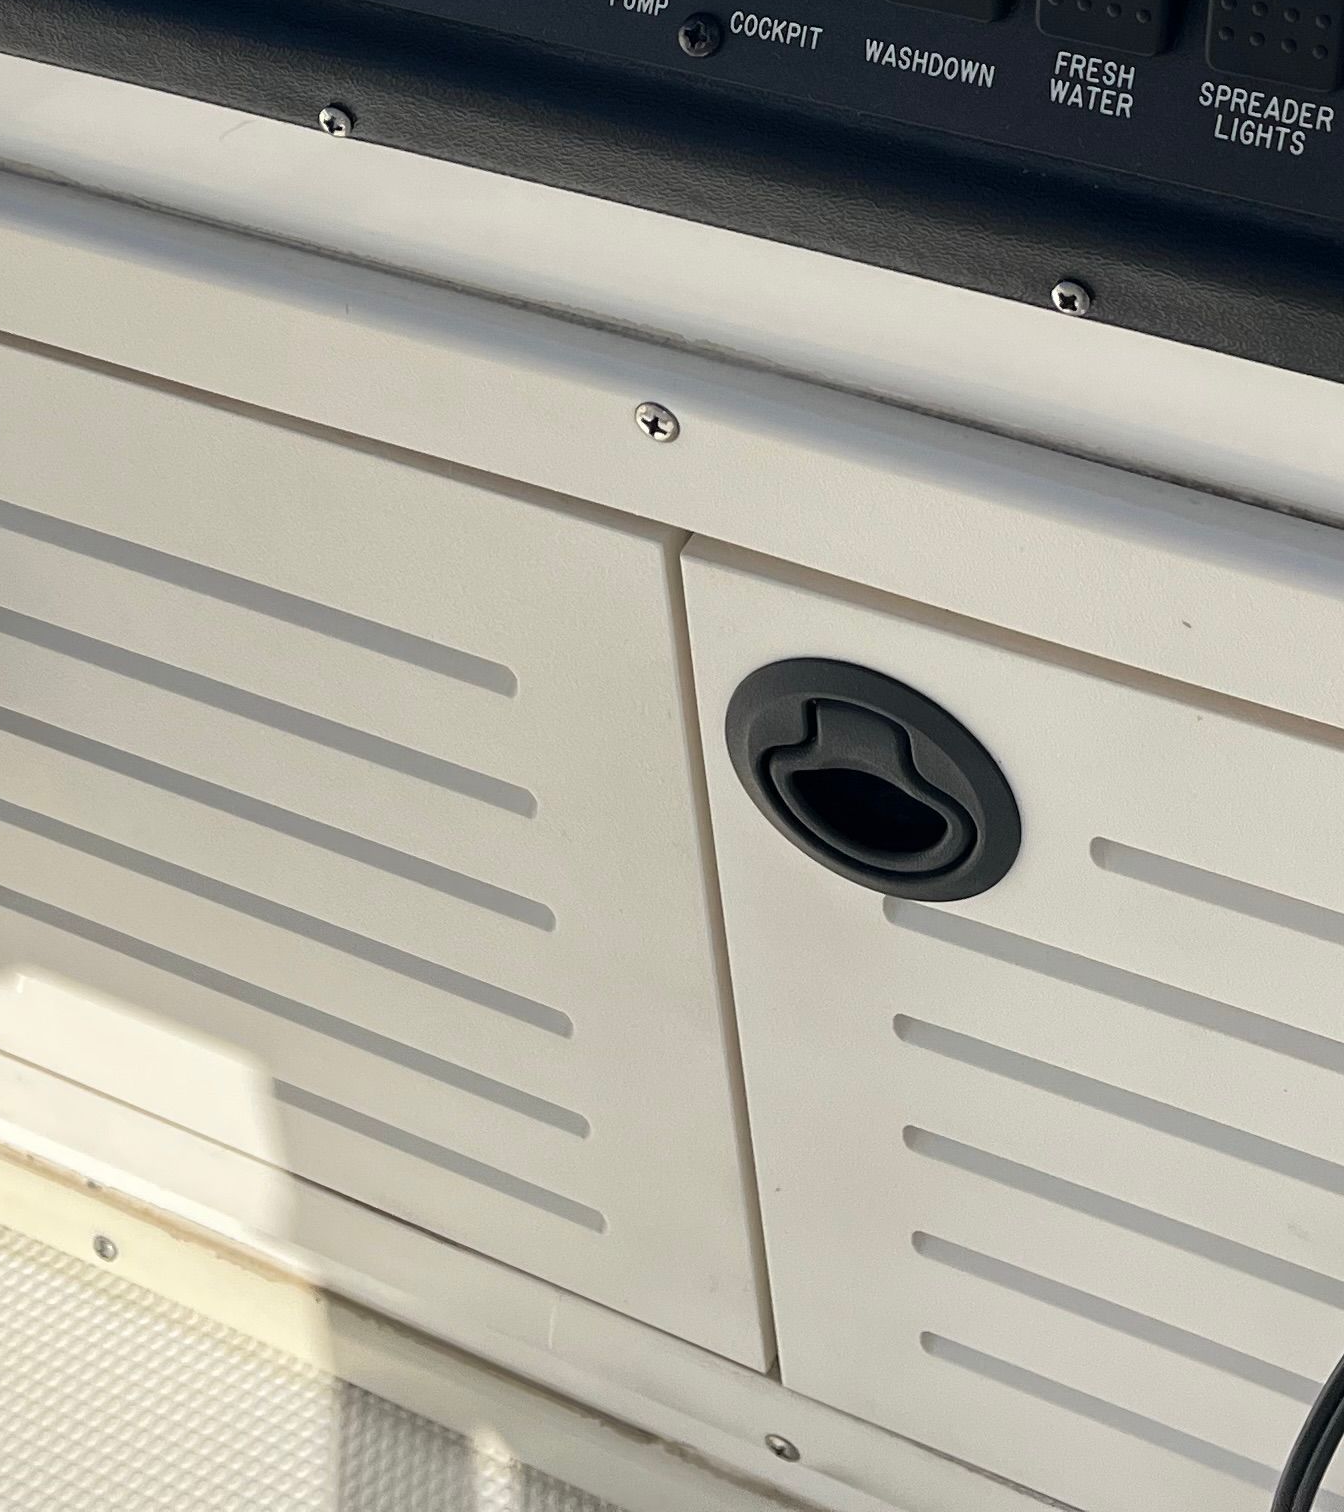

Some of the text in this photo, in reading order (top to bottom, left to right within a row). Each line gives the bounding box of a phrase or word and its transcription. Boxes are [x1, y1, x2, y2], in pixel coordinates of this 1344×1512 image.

[730, 11, 824, 50] COCKPIT
[865, 38, 996, 88] WASHDOWN
[1054, 51, 1135, 90] FRESH
[1049, 79, 1134, 118] WATER
[1198, 81, 1335, 133] SPREADER
[1213, 114, 1306, 156] LIGHTS
